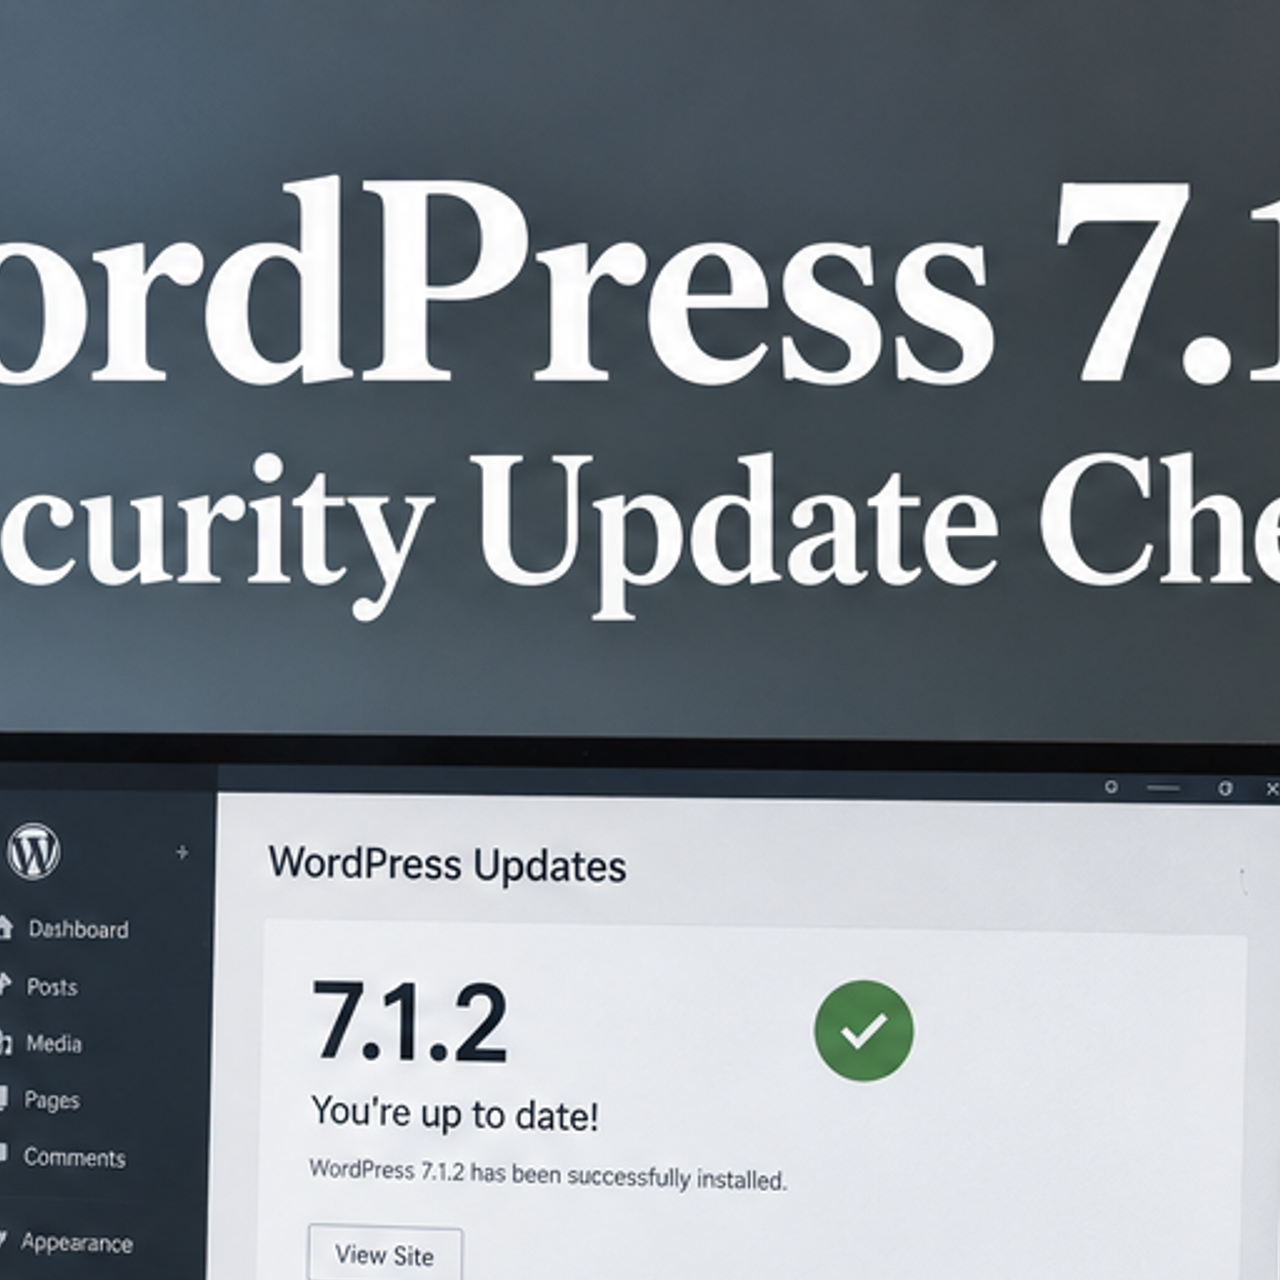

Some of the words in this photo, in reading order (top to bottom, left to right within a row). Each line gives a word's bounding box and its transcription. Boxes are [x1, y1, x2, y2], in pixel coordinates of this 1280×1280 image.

[268, 844, 462, 881] WordPress
[474, 847, 627, 890] Updates
[29, 919, 129, 939] Dashboard
[27, 977, 79, 997] Posts
[313, 980, 507, 1063] 7.1.2
[26, 1033, 82, 1054] Media
[25, 1089, 81, 1114] Pages
[311, 1094, 411, 1127] You're
[422, 1104, 462, 1136] up
[471, 1101, 506, 1129] to
[515, 1099, 598, 1132] date!
[23, 1145, 126, 1169] Comments
[309, 1158, 416, 1181] WordPress
[422, 1160, 465, 1182] 7.1.2
[470, 1162, 507, 1184] has
[512, 1162, 562, 1184] been
[567, 1166, 692, 1194] successfully
[697, 1167, 787, 1192] installed.
[20, 1231, 134, 1256] Appearance
[335, 1244, 387, 1265] View
[394, 1245, 435, 1267] Site
